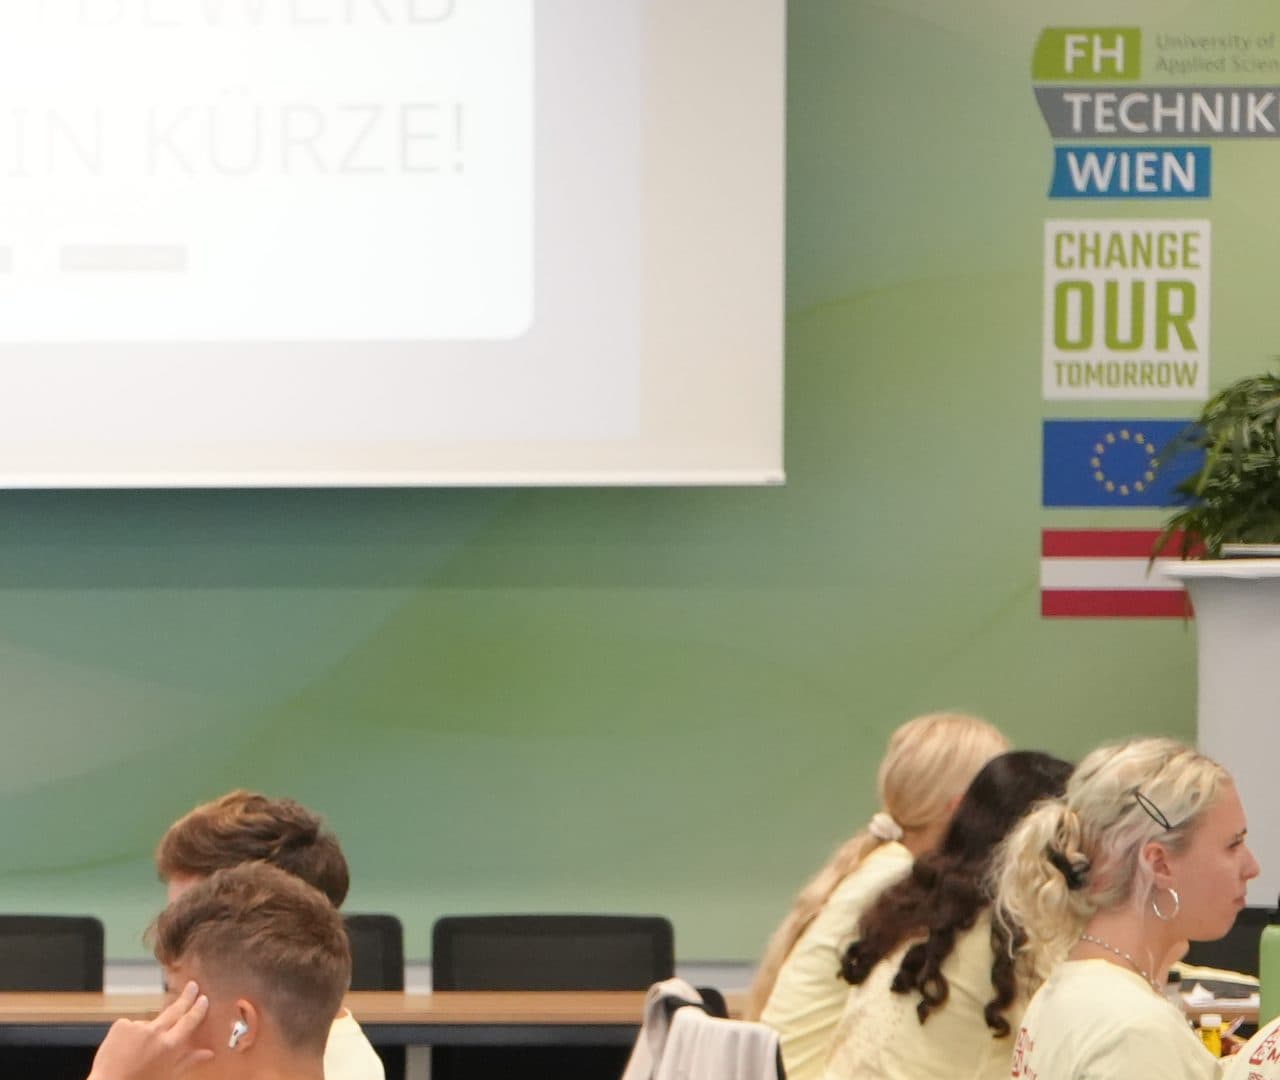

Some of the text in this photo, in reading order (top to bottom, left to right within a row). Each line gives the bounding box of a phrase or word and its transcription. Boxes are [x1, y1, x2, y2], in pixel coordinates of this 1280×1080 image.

[1064, 34, 1125, 73] FH
[1155, 33, 1250, 54] University
[1156, 55, 1226, 75] Applied
[1063, 92, 1280, 133] TECHNIK
[7, 105, 104, 179] IN
[144, 86, 466, 176] KÜRZE!
[1067, 152, 1195, 192] WIEN
[1055, 231, 1200, 269] CHANGE
[1054, 280, 1198, 352] OUR
[1054, 361, 1198, 388] TOMORROW
